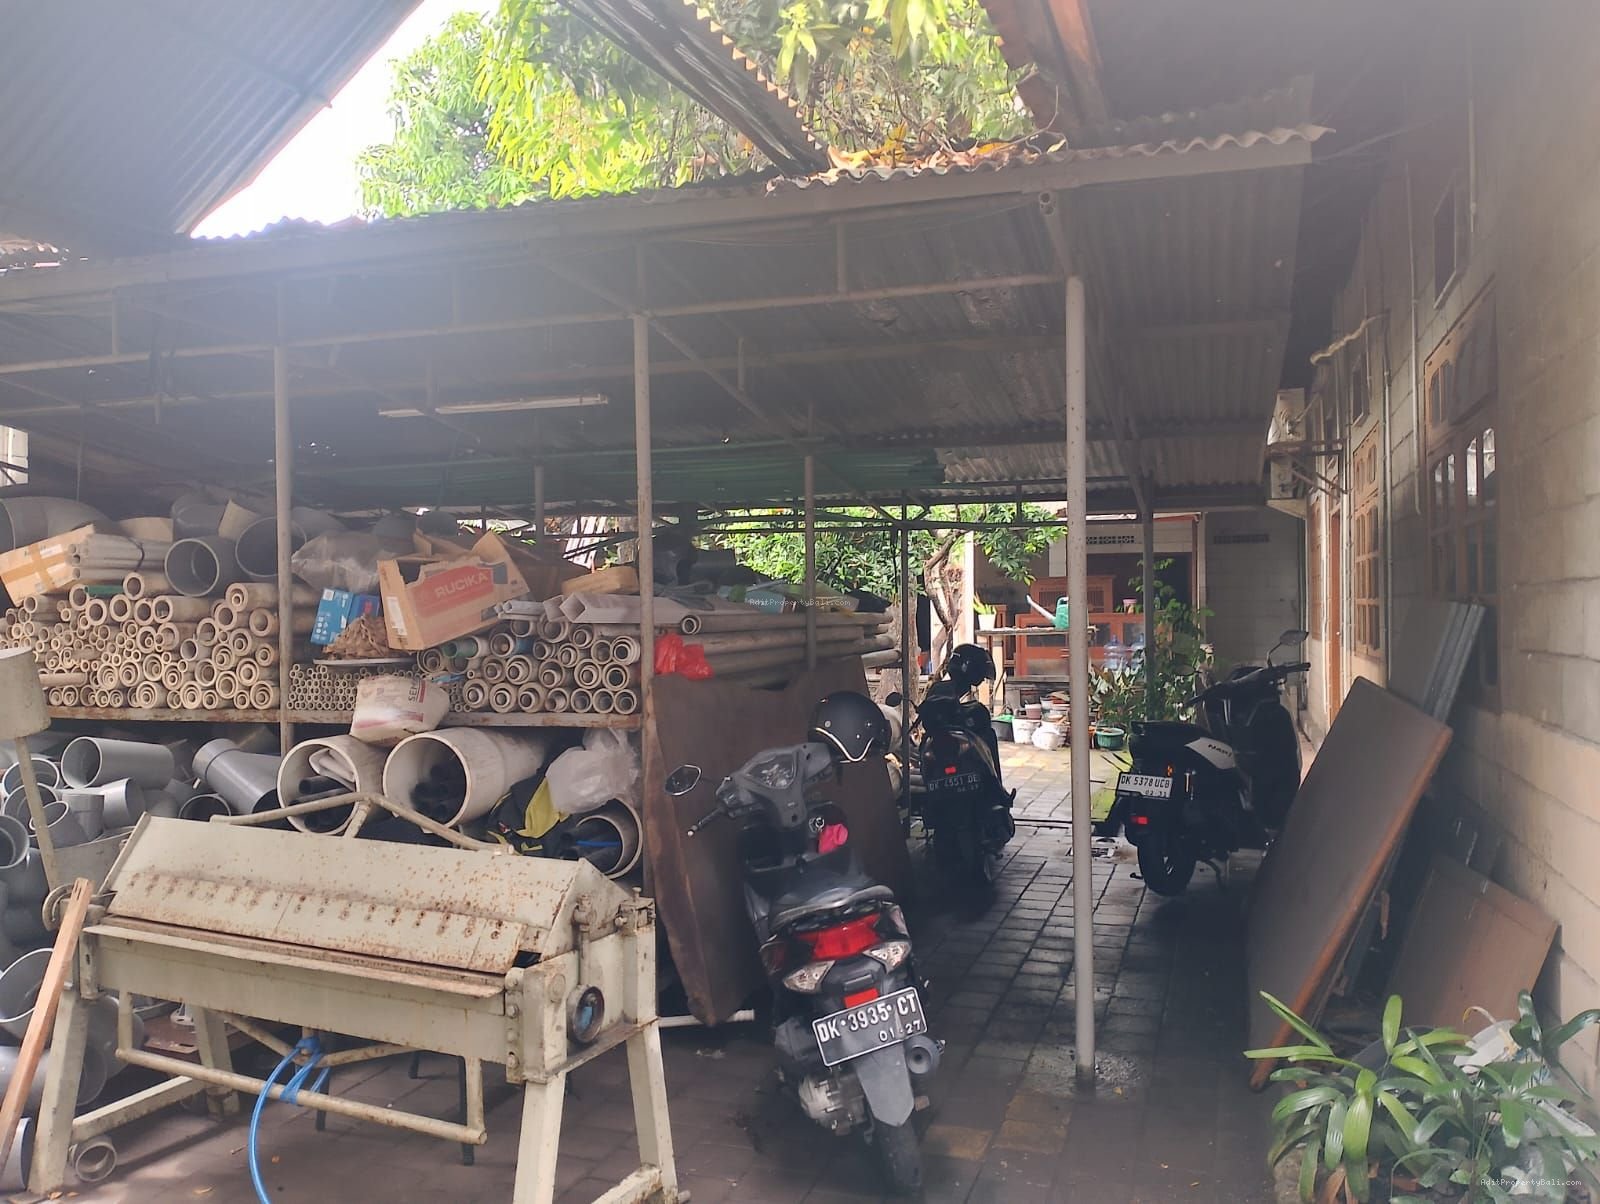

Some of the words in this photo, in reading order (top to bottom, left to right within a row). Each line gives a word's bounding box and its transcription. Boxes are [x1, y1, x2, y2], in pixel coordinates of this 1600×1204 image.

[434, 572, 489, 598] RUCIKA
[1121, 775, 1131, 785] DK
[1134, 776, 1153, 787] 5378
[817, 1018, 841, 1043] DK
[847, 1002, 889, 1031] 3935
[896, 993, 917, 1015] CT
